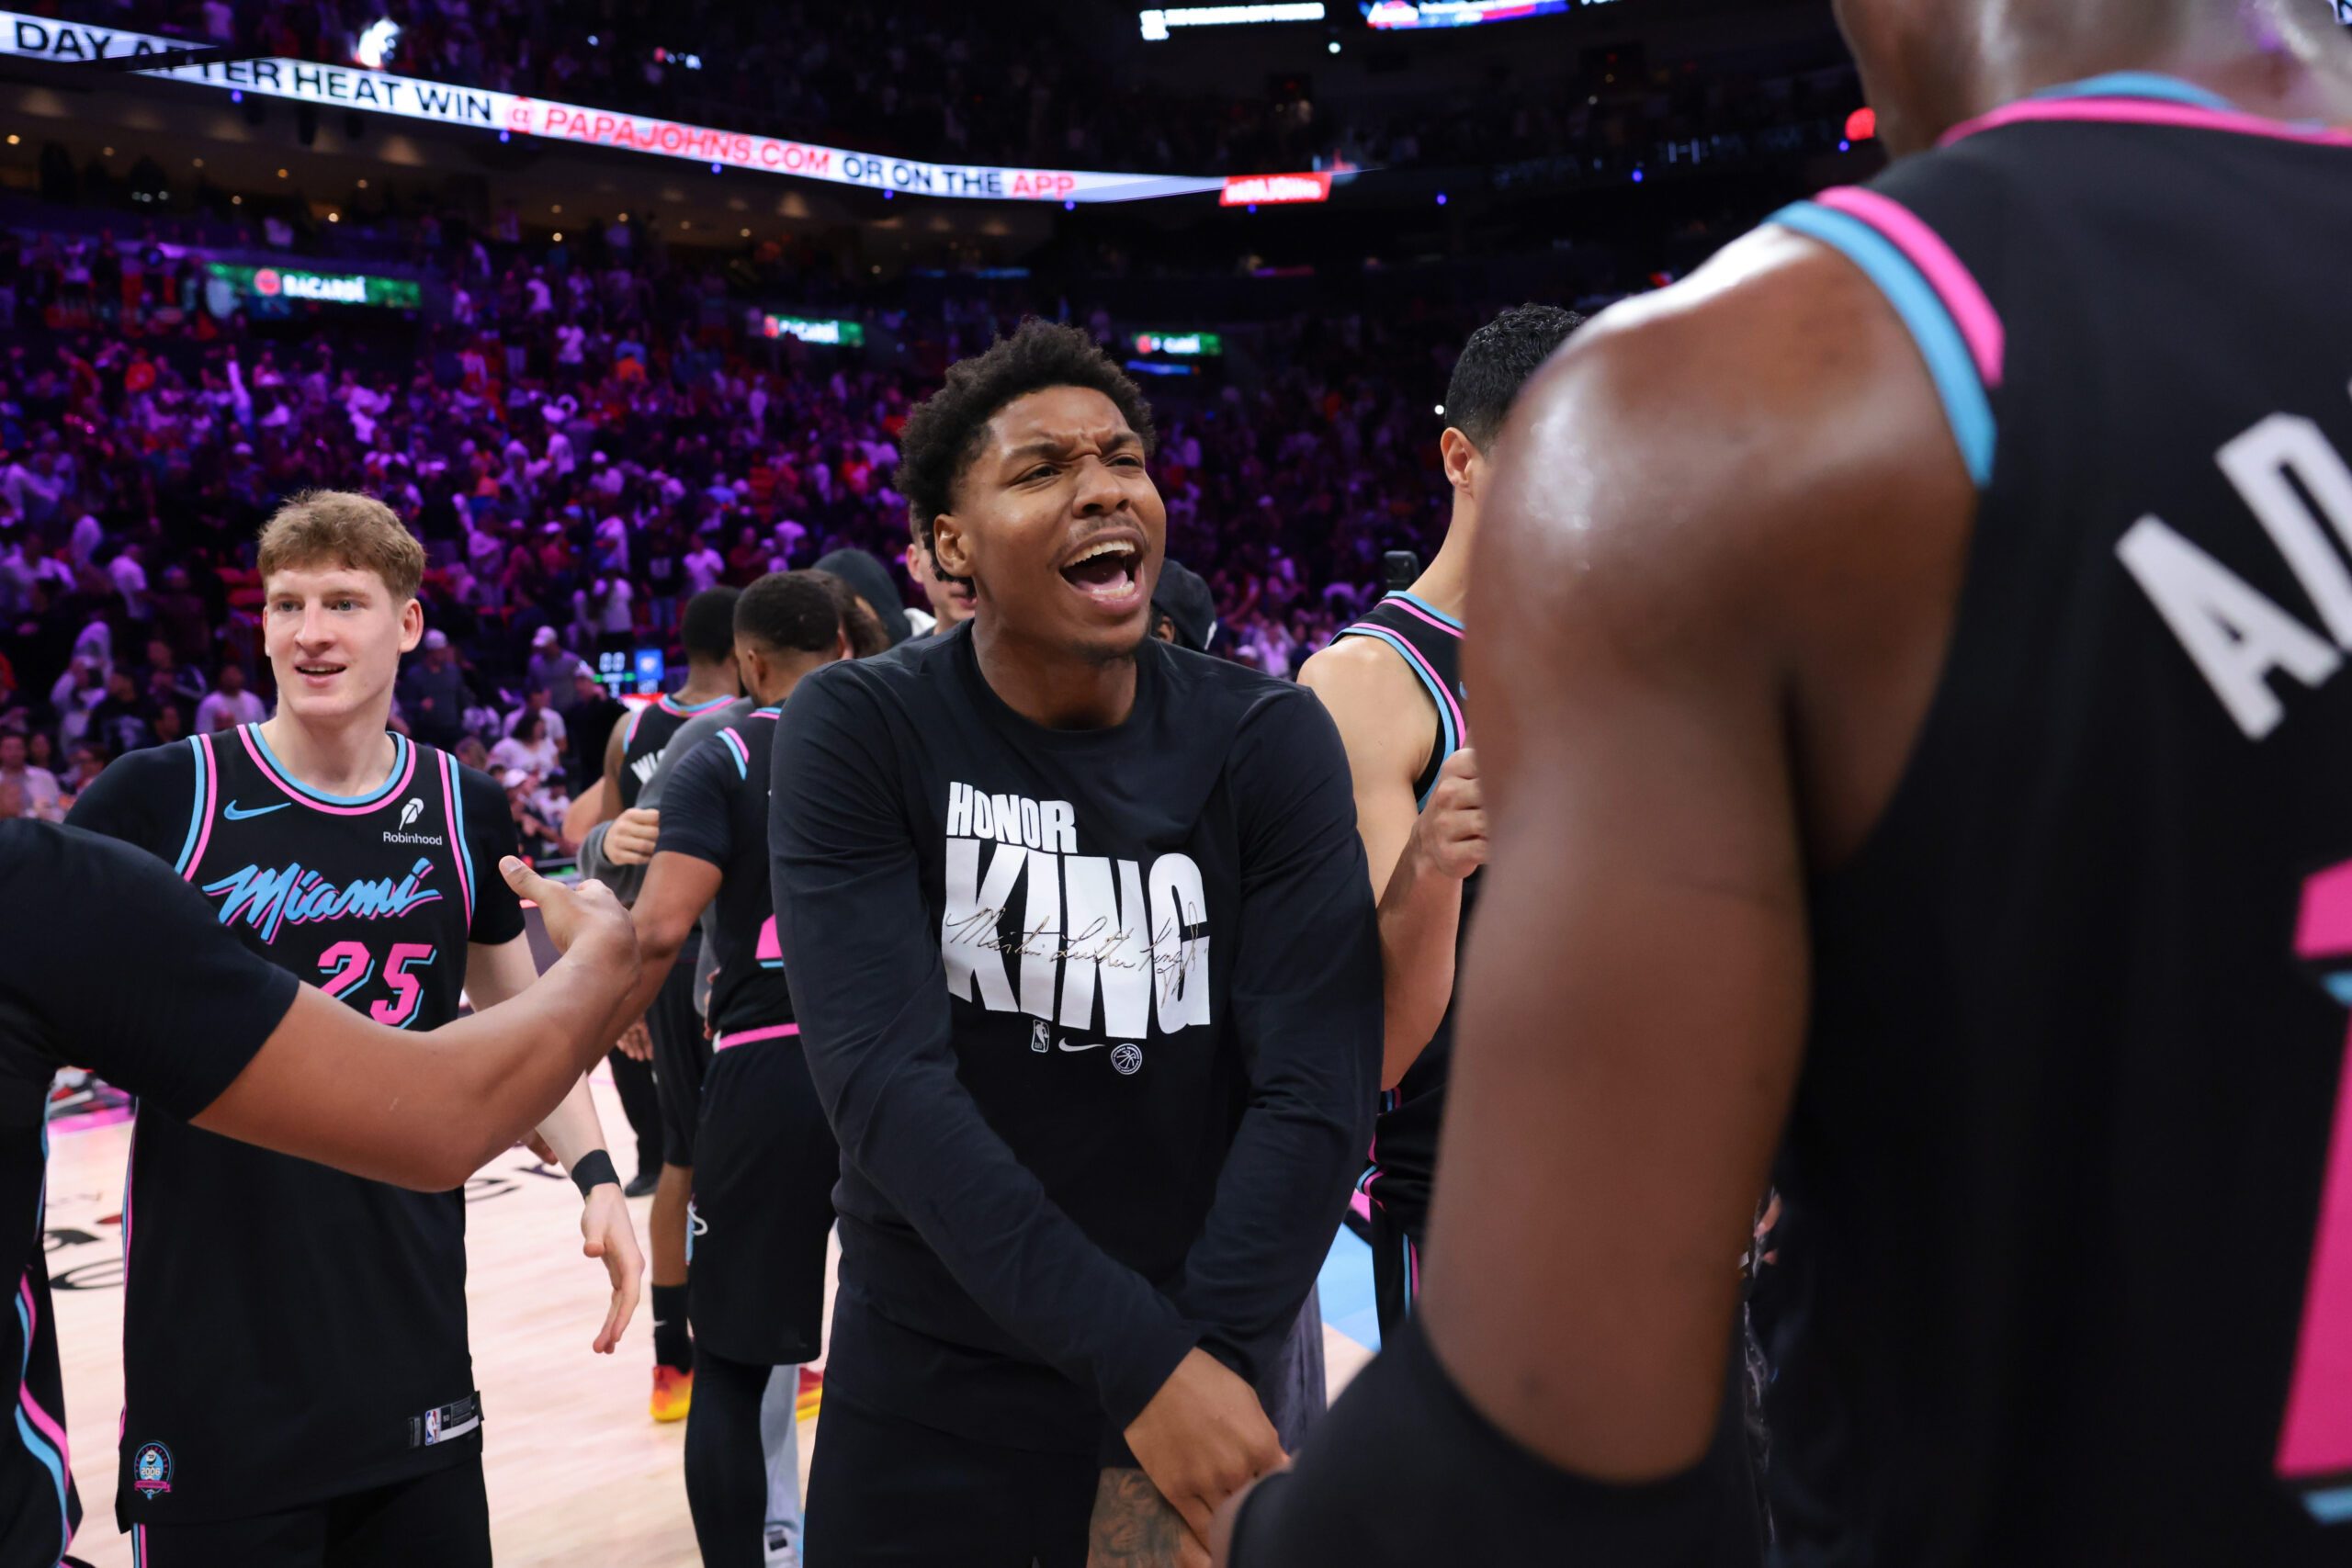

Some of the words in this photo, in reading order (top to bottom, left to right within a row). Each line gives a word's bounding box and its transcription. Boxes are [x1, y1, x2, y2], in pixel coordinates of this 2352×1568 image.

[15, 20, 111, 61] DAY
[132, 39, 281, 88] AER
[294, 66, 401, 106] HEAT
[415, 85, 492, 121] WIN
[545, 107, 831, 174] PAPAJOHNS.COM
[843, 157, 883, 182] OR
[892, 164, 932, 188] ON
[942, 171, 1002, 193] THE
[1012, 174, 1075, 196] APP
[2114, 377, 2352, 741] AD
[629, 749, 668, 784] WI
[382, 831, 442, 846] Robinhood
[946, 781, 1079, 854] HONOR
[201, 857, 443, 945] Miami
[941, 837, 1211, 1040] KING
[317, 942, 437, 1030] 25
